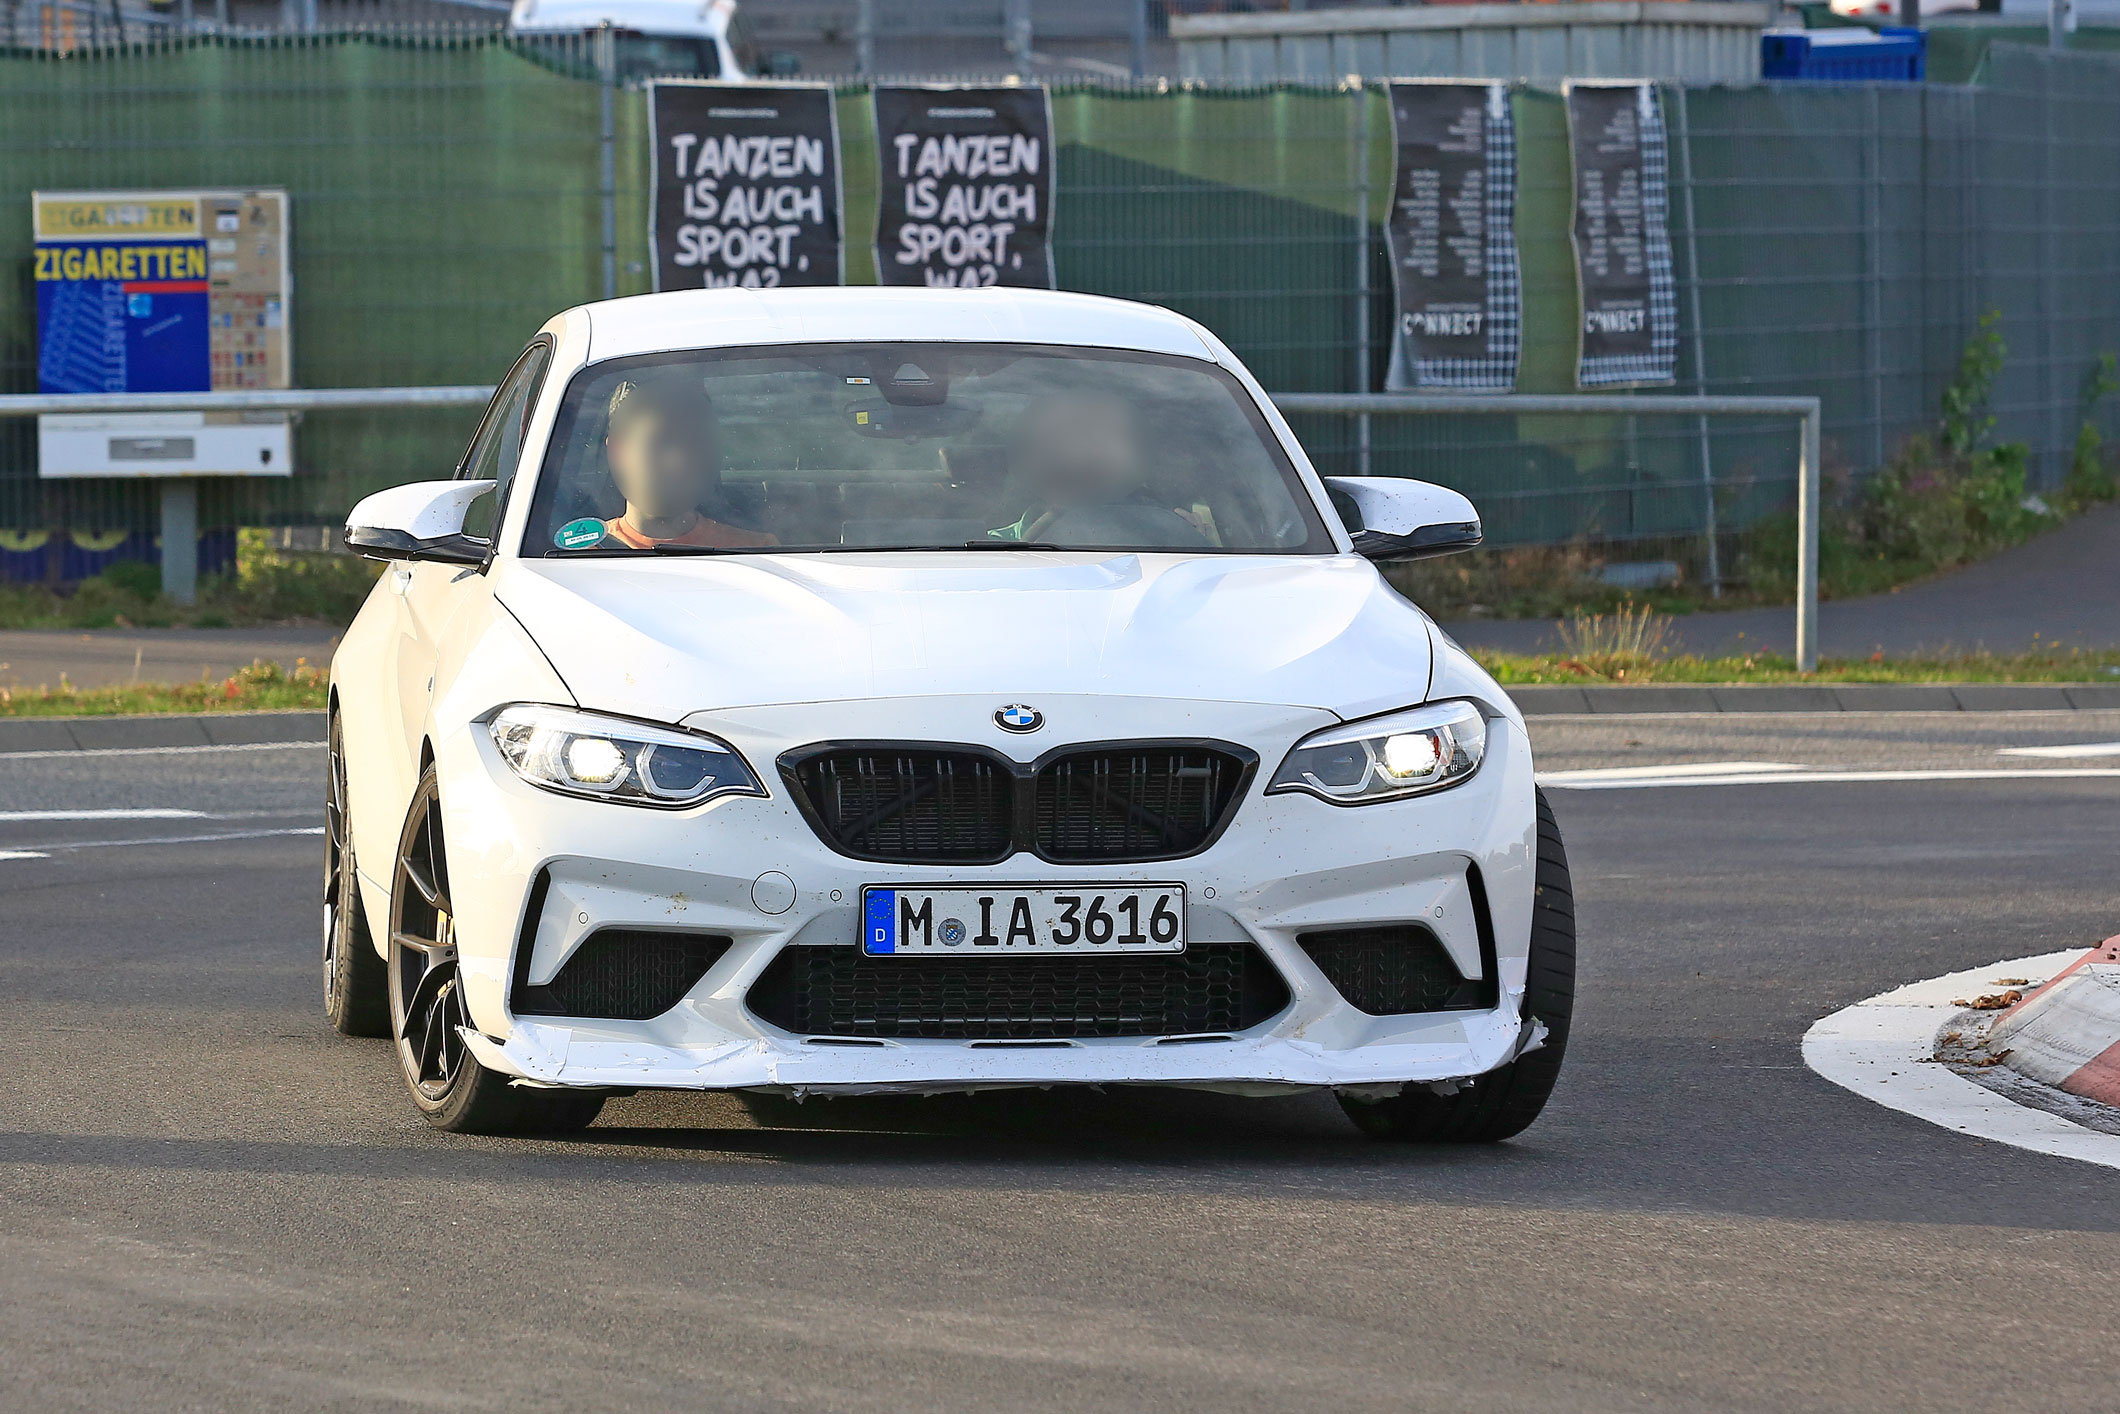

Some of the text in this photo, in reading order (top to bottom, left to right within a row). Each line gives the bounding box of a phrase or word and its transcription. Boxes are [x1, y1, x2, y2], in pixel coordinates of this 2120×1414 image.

[671, 134, 824, 180] TANZEN
[894, 133, 1040, 179] TANZEN
[684, 177, 824, 227] IS AUCH
[905, 177, 1037, 225] IS AUCH
[34, 245, 207, 281] ZIGARETTEN
[674, 223, 810, 273] SPORT,
[895, 222, 1023, 271] SPORT,
[875, 928, 886, 942] D
[900, 896, 933, 946] M
[973, 896, 1037, 946] IA
[1052, 894, 1179, 945] 3616
